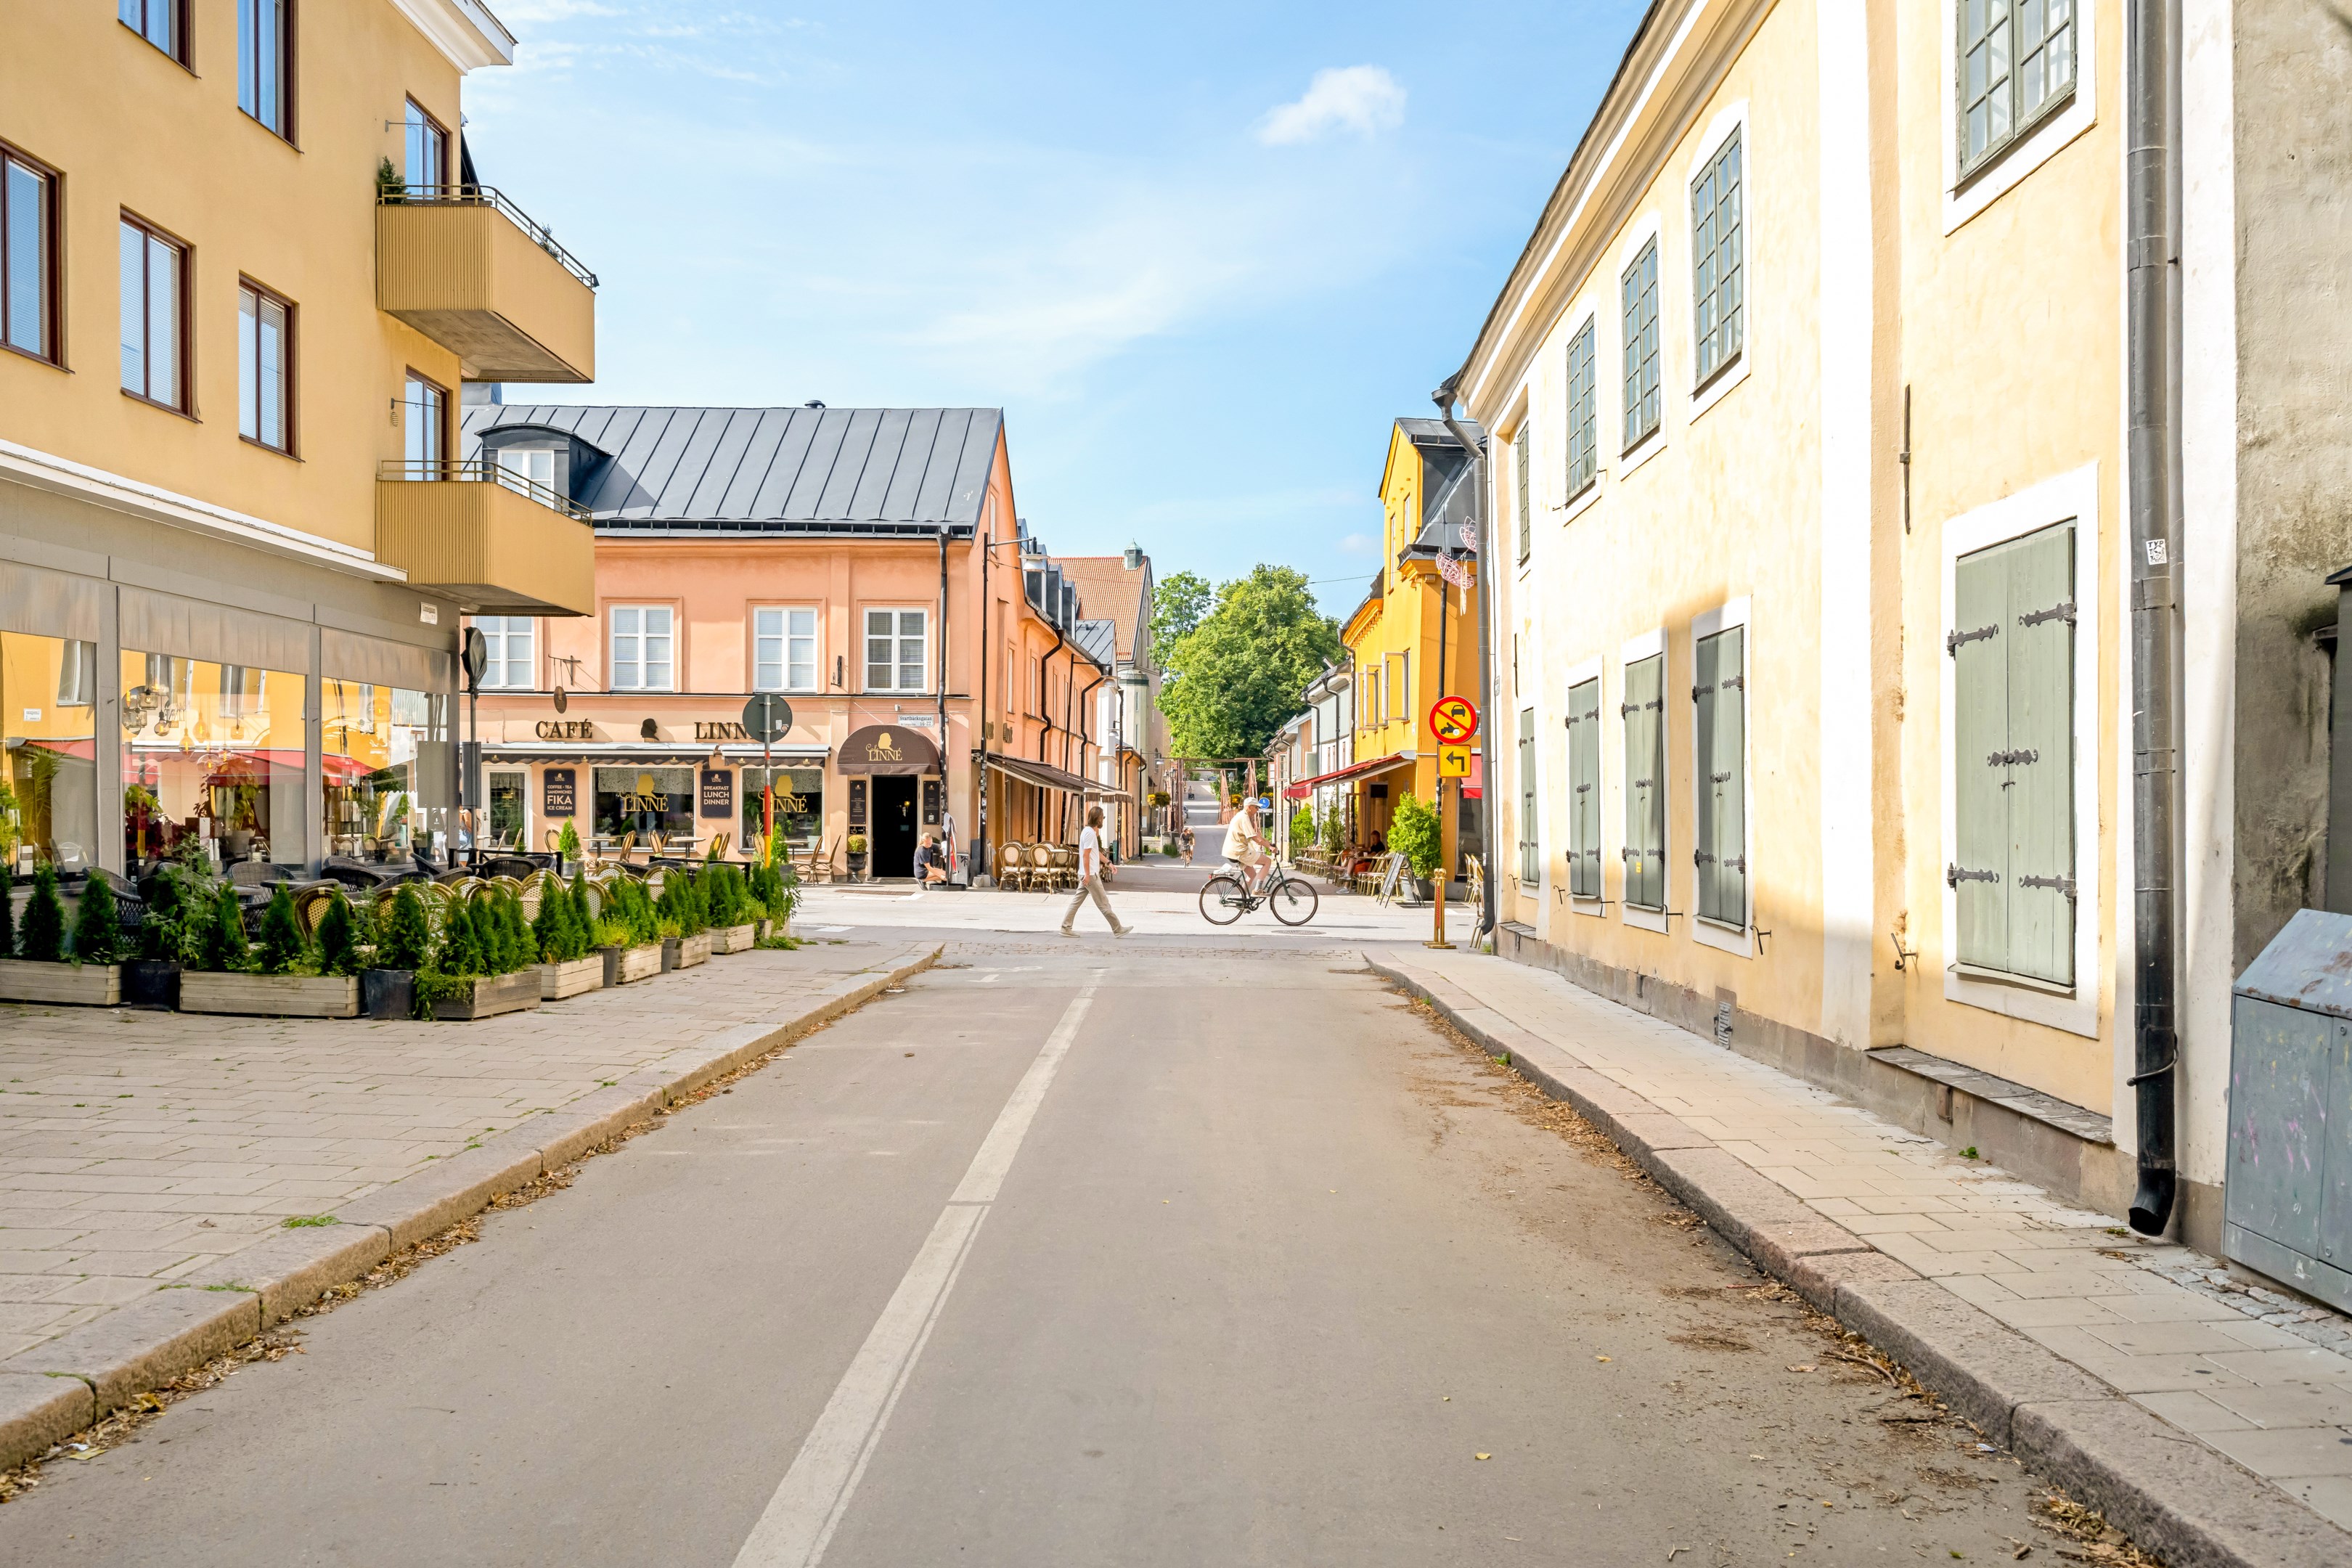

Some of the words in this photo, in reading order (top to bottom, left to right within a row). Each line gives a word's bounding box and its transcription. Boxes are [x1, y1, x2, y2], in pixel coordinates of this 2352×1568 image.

[535, 718, 592, 739] CAFÉ
[694, 722, 756, 740] LINN
[868, 747, 902, 761] LINNÉ
[547, 795, 573, 805] FIKA
[624, 793, 669, 812] LINNÉ
